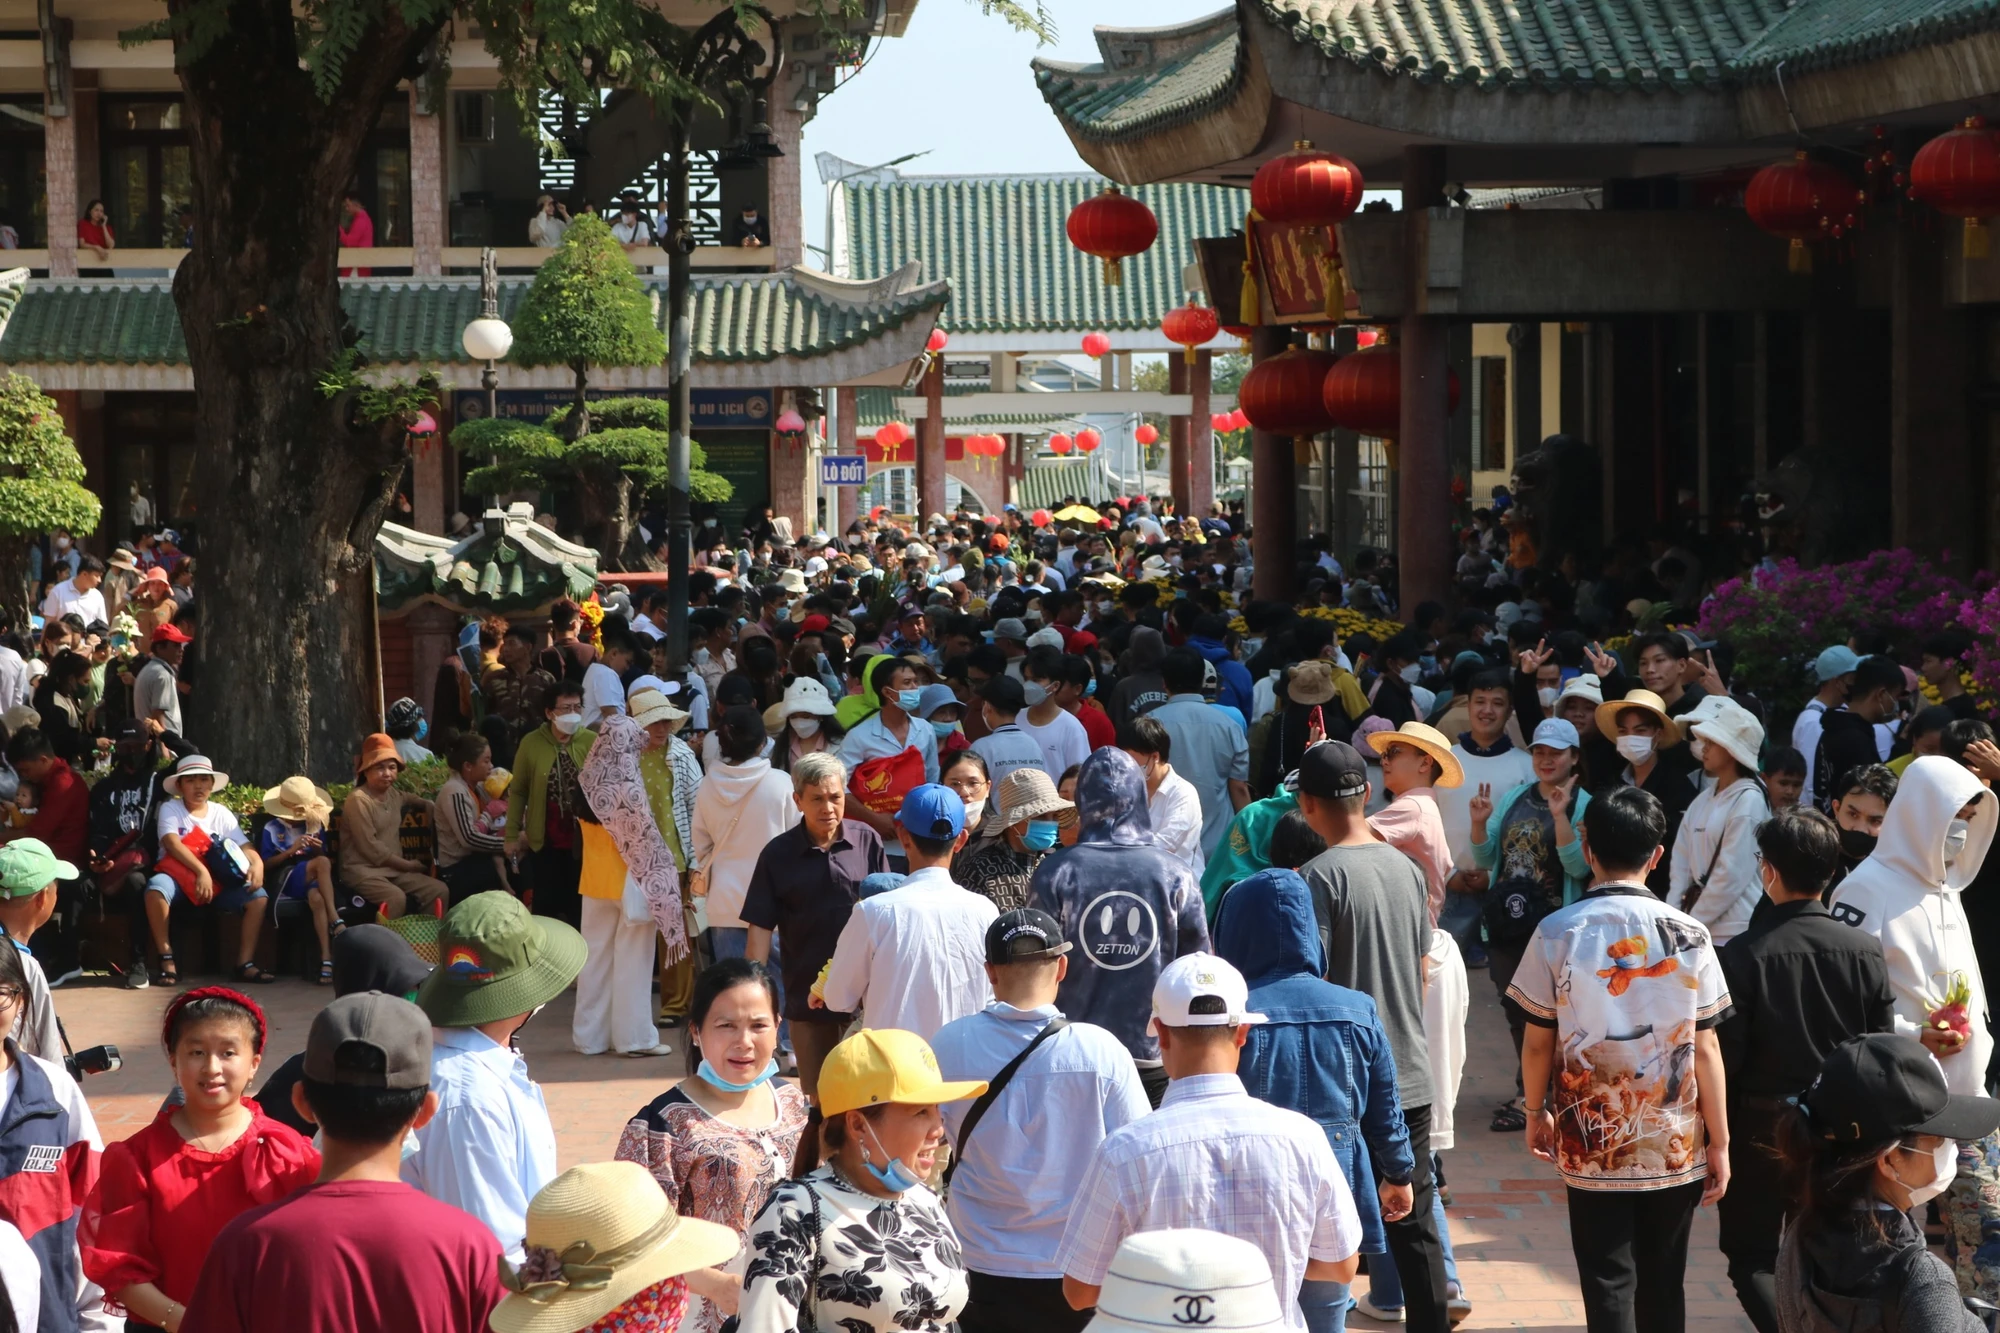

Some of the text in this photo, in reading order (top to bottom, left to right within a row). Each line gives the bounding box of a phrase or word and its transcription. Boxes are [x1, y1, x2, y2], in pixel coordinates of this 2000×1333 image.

[700, 403, 714, 414] DU
[719, 403, 745, 416] LỊCH
[824, 460, 863, 481] LÒ ĐỐT
[1096, 943, 1140, 955] ZETTON
